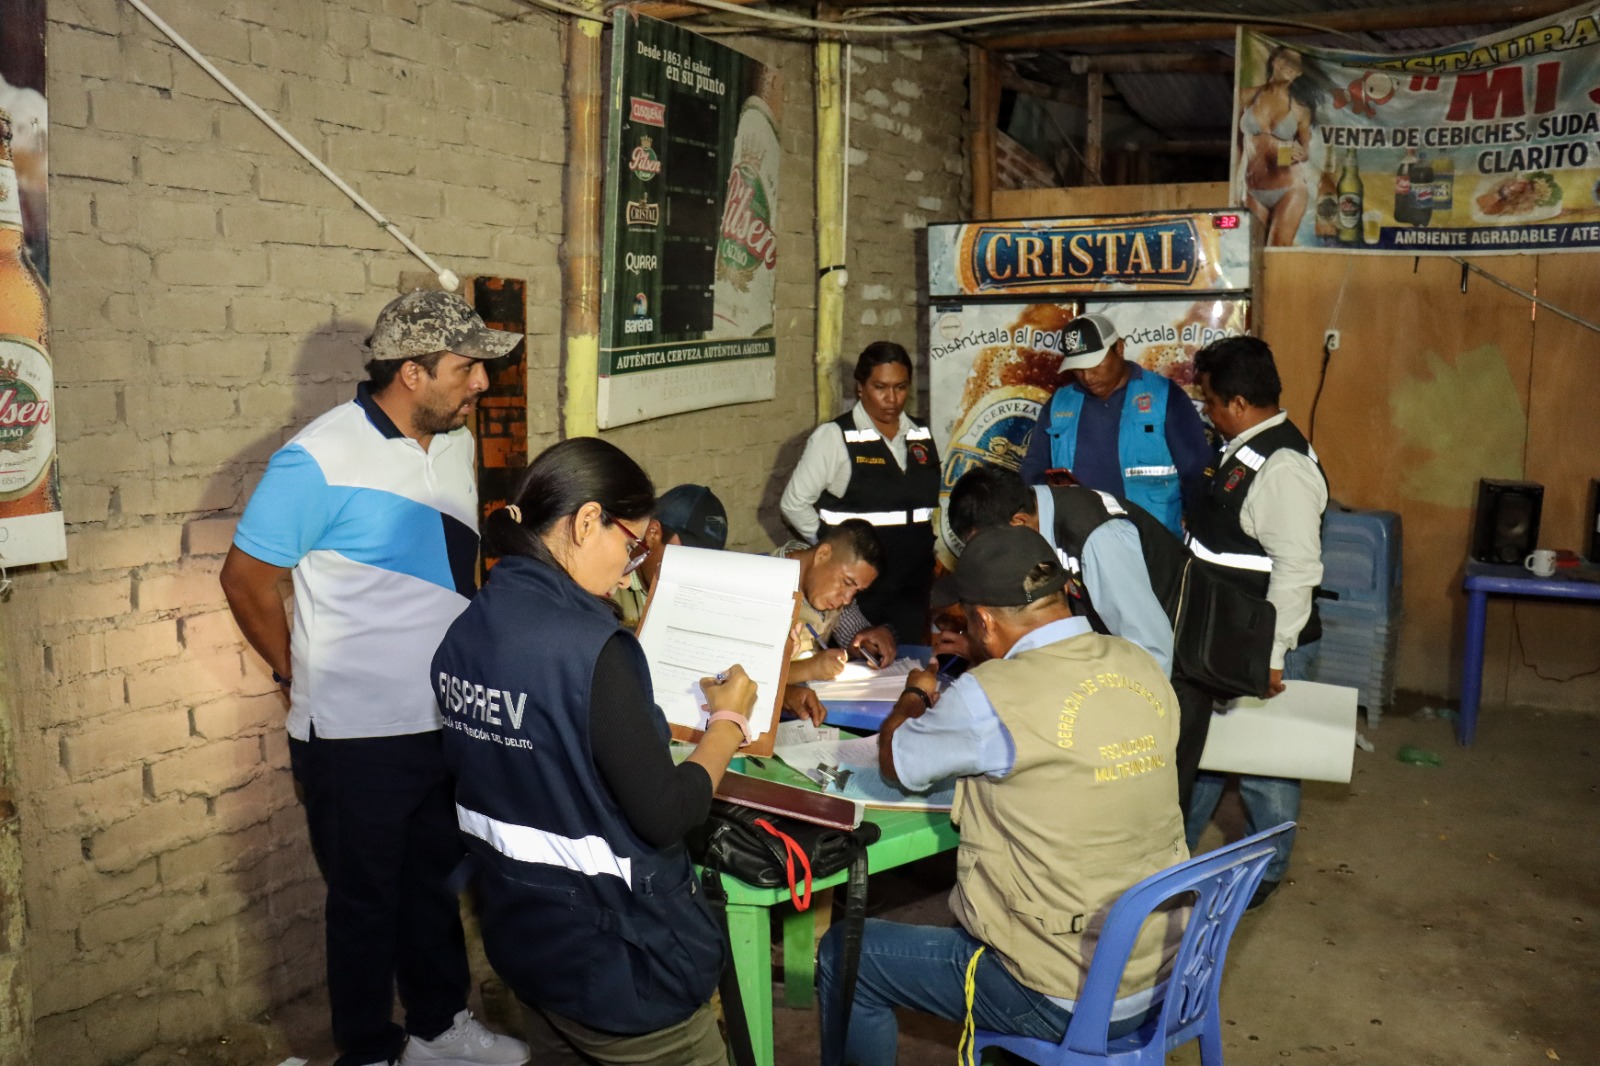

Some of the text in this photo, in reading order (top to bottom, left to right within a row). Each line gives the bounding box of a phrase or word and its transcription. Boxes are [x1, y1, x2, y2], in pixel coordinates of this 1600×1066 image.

[637, 40, 711, 76] Desde 1863, el sabor
[666, 65, 726, 96] en su punto
[633, 104, 663, 121] CUSQUEÑA
[1321, 112, 1600, 147] VENTA DE CEBICHES, SUDA
[629, 146, 661, 174] Pilsen
[1477, 141, 1589, 174] CLARITO
[630, 206, 656, 221] CRISTAL
[1394, 230, 1467, 245] AMBIENTE
[1471, 228, 1557, 244] AGRADABLE
[984, 231, 1187, 280] CRISTAL
[1015, 327, 1028, 343] al
[1182, 323, 1197, 342] al
[616, 352, 666, 370] AUTÉNTICA
[703, 343, 742, 358] AUTÉNTICA
[983, 402, 1038, 424] CERVEZA
[439, 671, 528, 730] FISPREV
[1057, 690, 1085, 749] GERENCIA
[1079, 679, 1099, 696] DE
[455, 720, 463, 731] DE
[504, 736, 533, 750] DELITO
